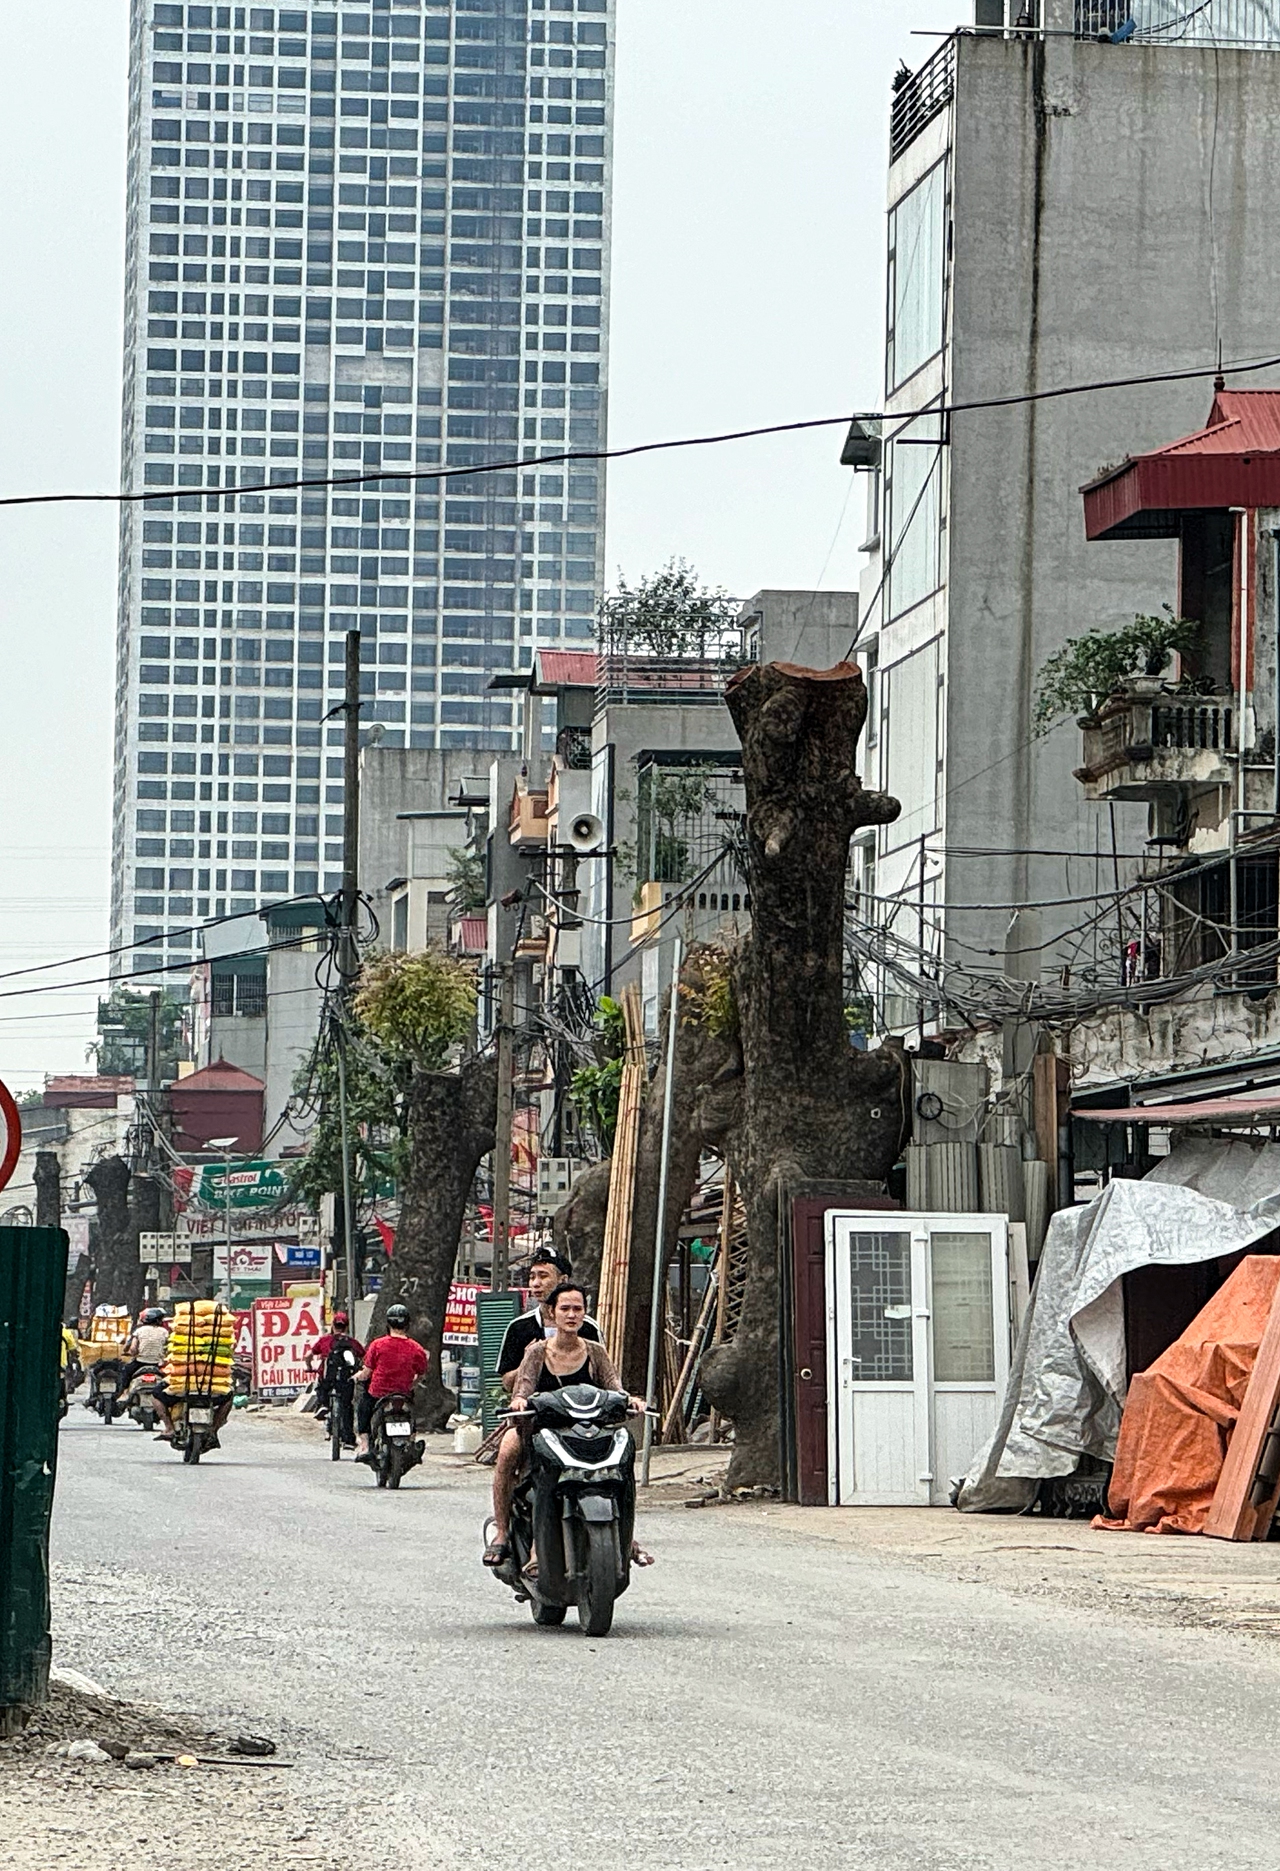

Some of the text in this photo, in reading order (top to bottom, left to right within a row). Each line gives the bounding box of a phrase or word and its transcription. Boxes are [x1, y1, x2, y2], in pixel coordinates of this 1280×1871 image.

[399, 1278, 419, 1297] 27
[260, 1301, 320, 1337] ĐÁ
[260, 1338, 313, 1364] ỐP LÁ
